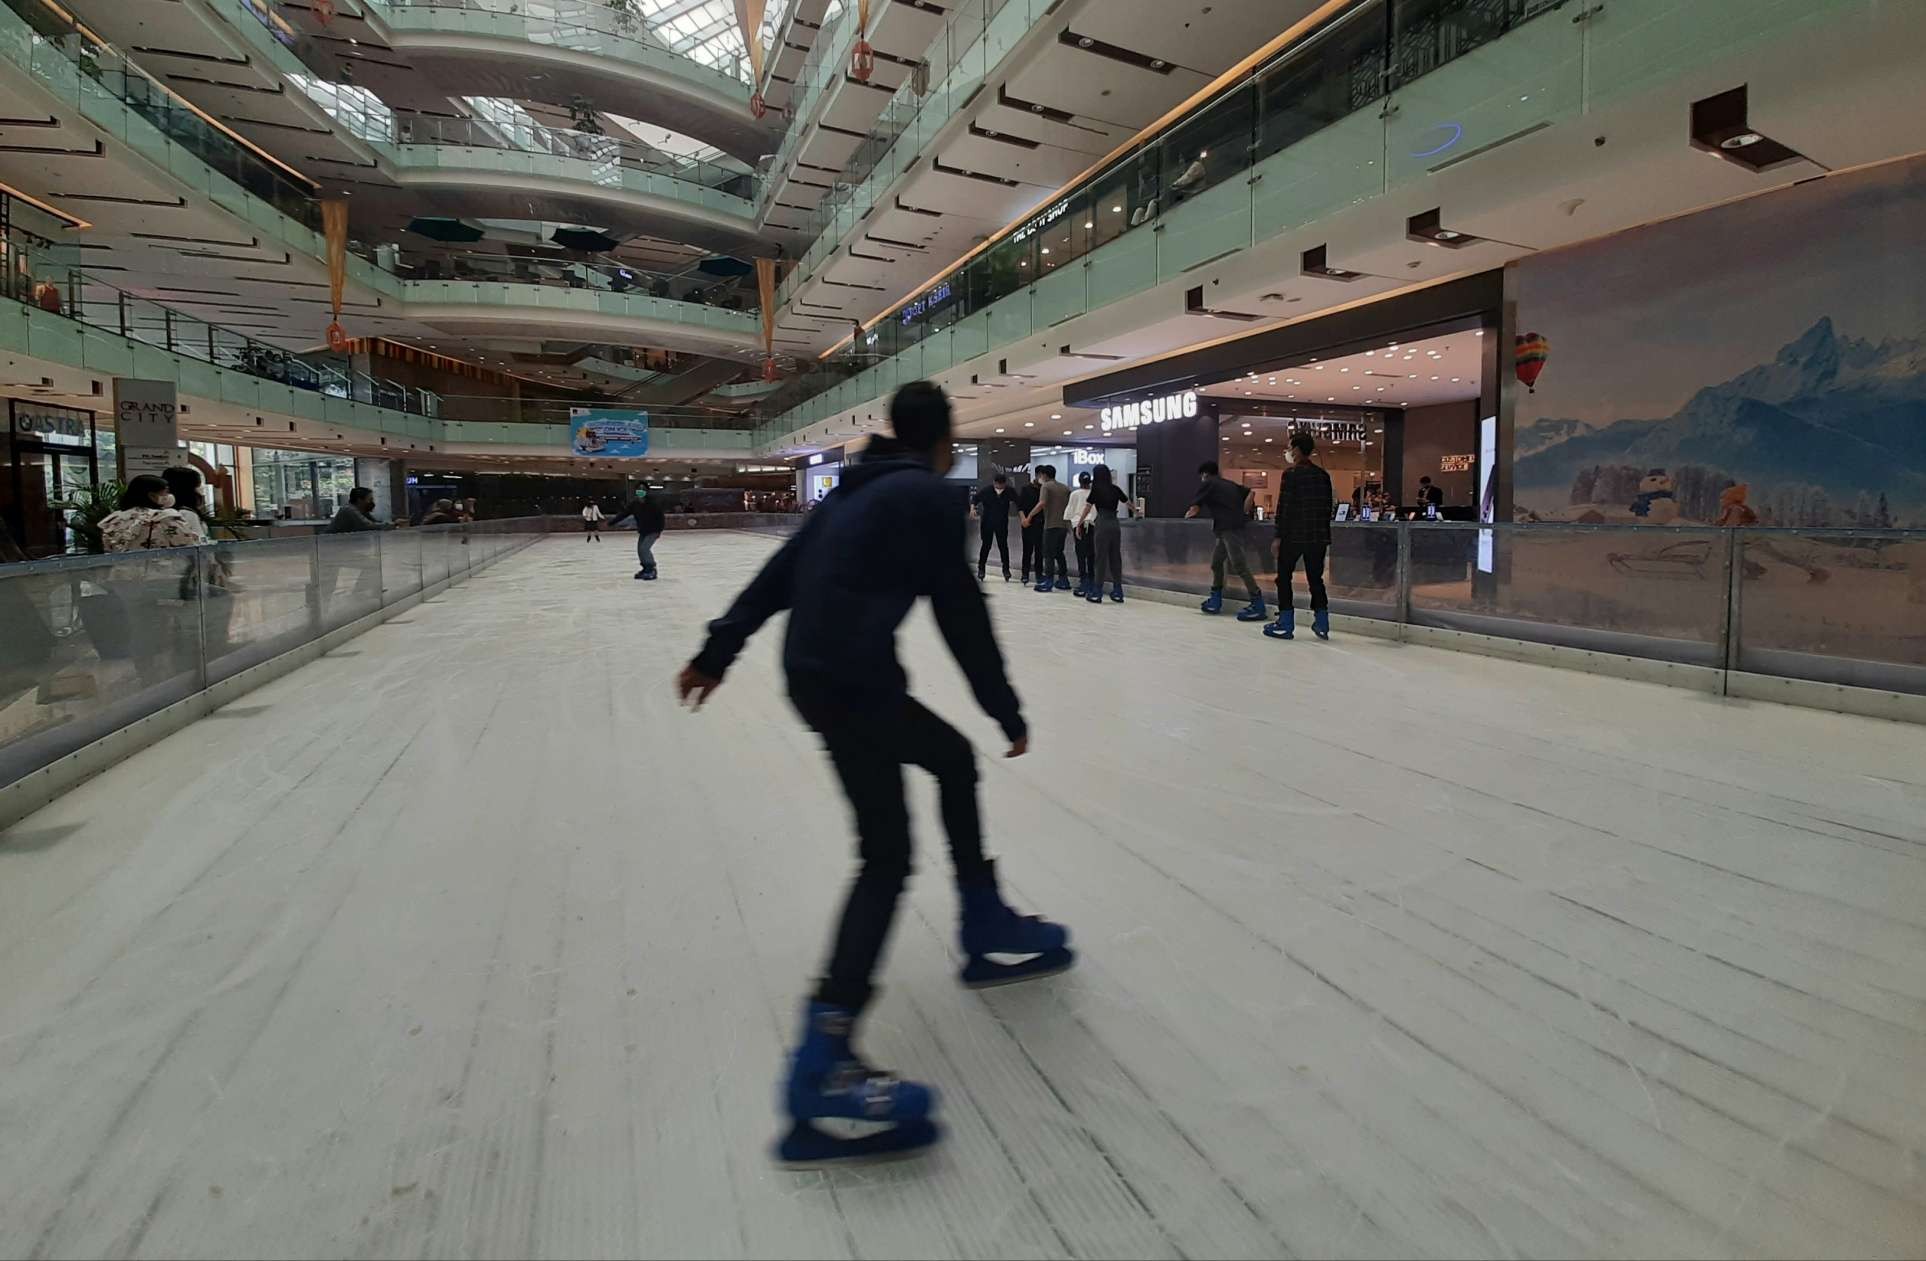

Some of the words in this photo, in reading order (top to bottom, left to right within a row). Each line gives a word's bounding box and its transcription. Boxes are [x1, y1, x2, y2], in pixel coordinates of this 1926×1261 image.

[120, 400, 175, 413] GRAND
[1100, 391, 1197, 431] SAMSUNG
[120, 412, 174, 424] CITY
[1071, 449, 1105, 464] iBox
